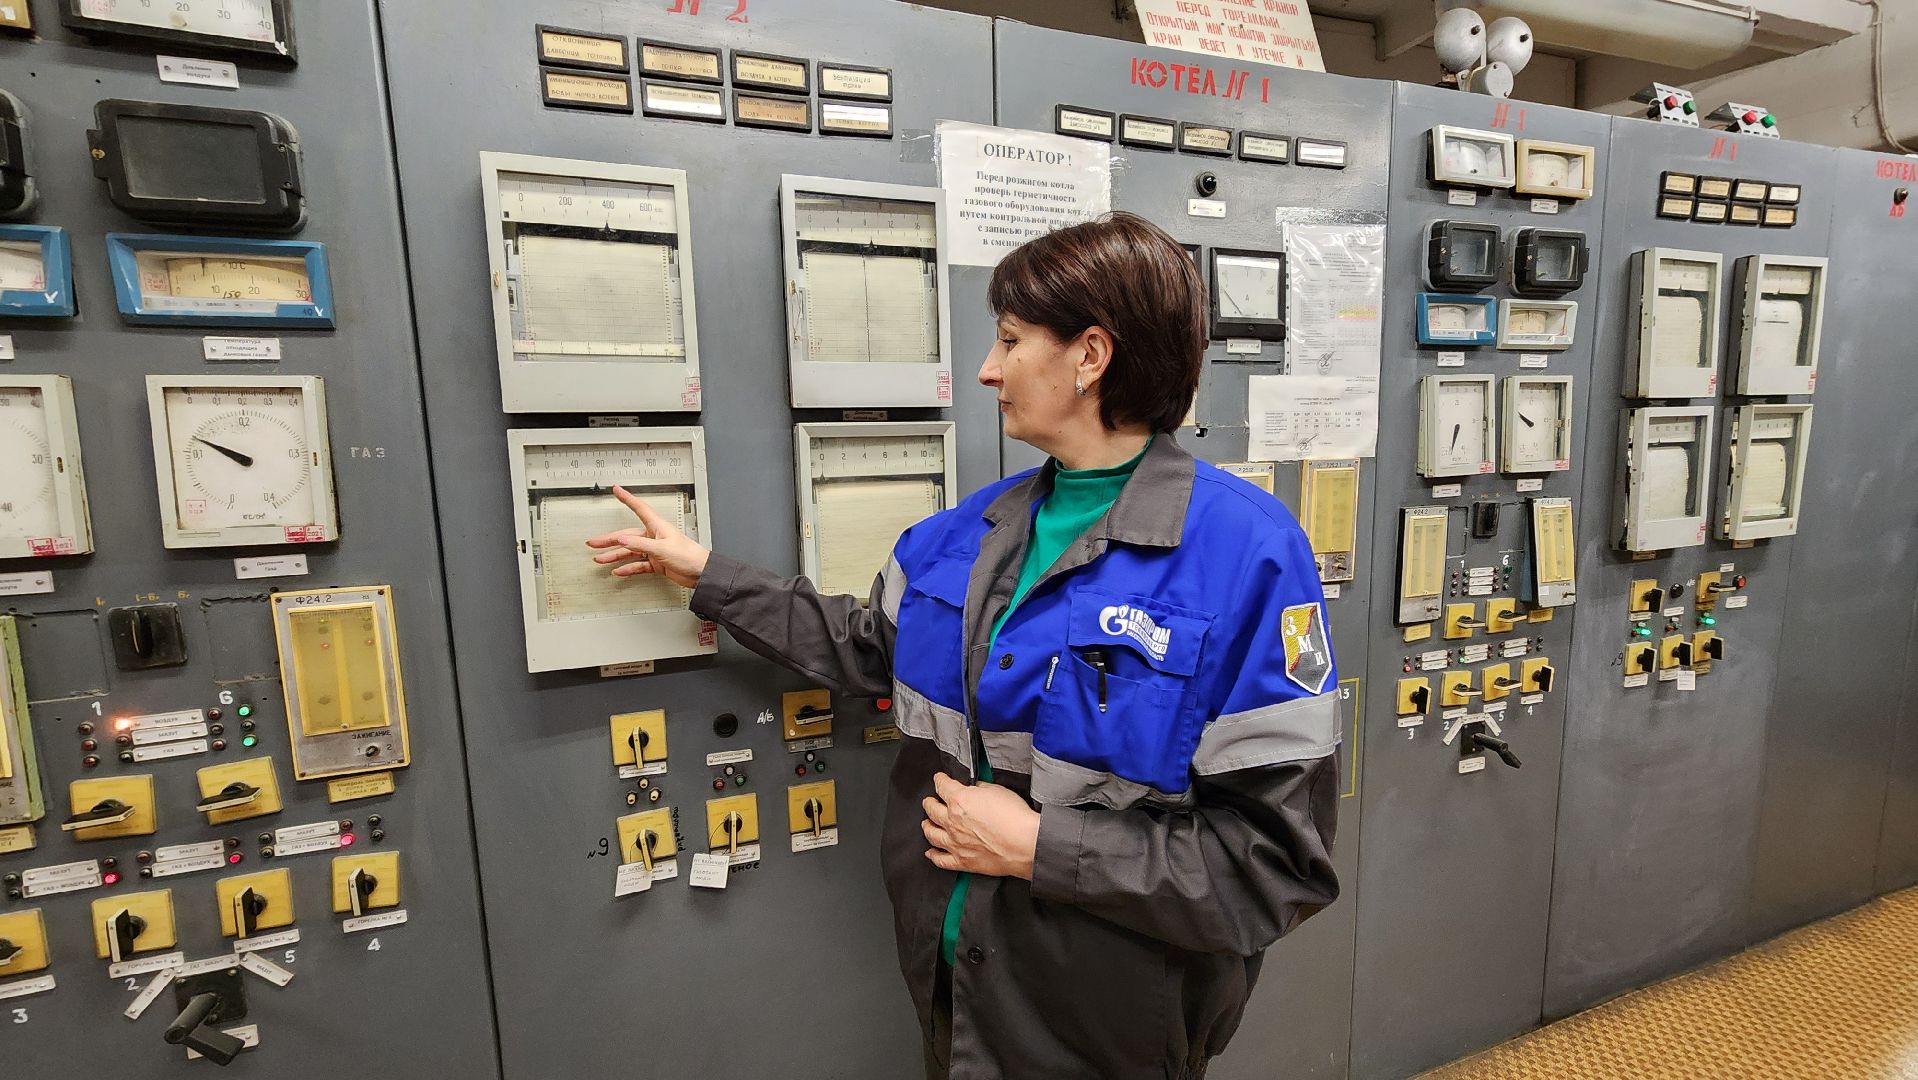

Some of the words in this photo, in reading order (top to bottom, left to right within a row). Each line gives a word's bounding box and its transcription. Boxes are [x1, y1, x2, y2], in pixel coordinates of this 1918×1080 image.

[1176, 0, 1212, 18] ПЕРЕД
[176, 2, 191, 12] 20
[217, 9, 232, 21] 30
[258, 20, 273, 31] 40
[983, 143, 1065, 165] ОПЕРАТОР
[976, 170, 1004, 183] Перед
[1006, 174, 1049, 188] розжигом
[1050, 181, 1076, 190] котла
[974, 185, 1012, 198] проверь
[1013, 189, 1077, 203] герметичность
[518, 192, 524, 202] 0
[558, 195, 573, 206] 200
[601, 200, 615, 210] 400
[639, 202, 653, 213] 600
[964, 198, 1004, 209] газового
[1005, 200, 1066, 215] оборудования
[959, 209, 987, 221] путем
[989, 212, 1048, 226] контрольной
[985, 224, 1023, 236] записью
[211, 285, 221, 294] 10
[248, 286, 261, 296] 20
[295, 290, 307, 300] 30
[187, 397, 193, 406] 0
[212, 397, 222, 407] 0,1
[237, 397, 248, 407] 0,2
[263, 397, 273, 407] 0,3
[288, 397, 299, 407] 0,4
[238, 416, 251, 428] 0,2
[32, 454, 43, 465] 30
[192, 449, 204, 460] 0,1
[288, 448, 300, 459] 0,3
[819, 453, 825, 461] 0
[841, 452, 847, 461] 2
[861, 452, 867, 460] 4
[883, 451, 888, 459] 6
[903, 450, 908, 458] 8
[920, 450, 927, 458] 10
[544, 458, 550, 470] 0
[570, 459, 579, 469] 40
[595, 459, 605, 469] 80
[620, 458, 632, 469] 120
[645, 458, 657, 468] 160
[263, 493, 275, 504] 0,4
[1502, 554, 1510, 566] 6
[219, 690, 234, 705] 6
[92, 701, 102, 716] 1
[1527, 704, 1534, 716] 4
[1443, 720, 1450, 731] 2
[1498, 711, 1505, 722] 5
[352, 728, 392, 741] ЗАЖИГАНИЕ
[1407, 728, 1415, 740] 3
[8, 797, 16, 805] 2
[367, 937, 381, 952] 4
[285, 950, 296, 964] 5
[124, 977, 140, 991] 2
[11, 1008, 28, 1024] 3
